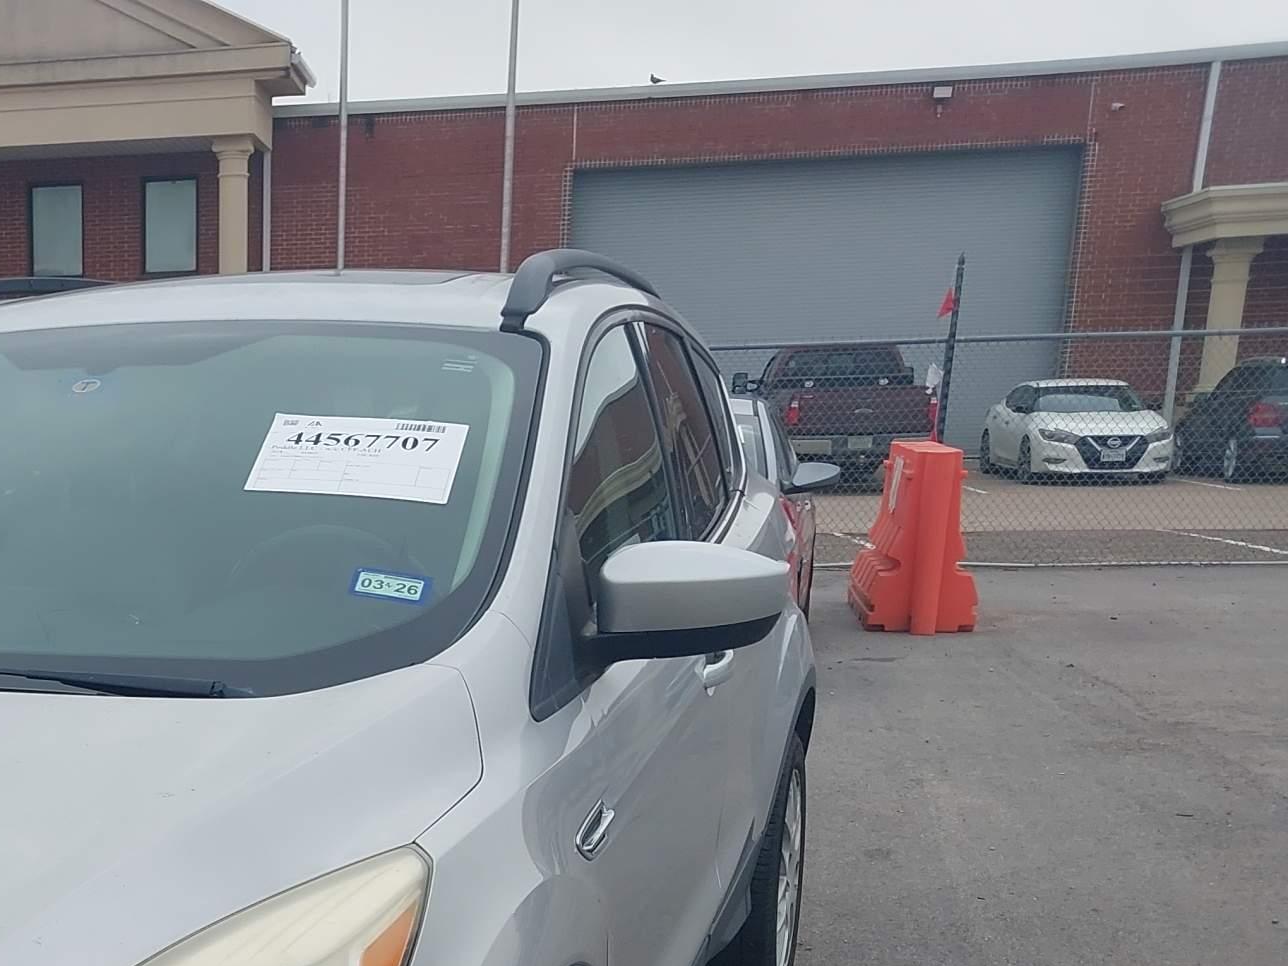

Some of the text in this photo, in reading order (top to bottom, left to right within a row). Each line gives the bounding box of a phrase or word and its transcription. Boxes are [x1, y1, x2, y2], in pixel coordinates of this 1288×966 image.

[286, 431, 441, 453] 44567707
[360, 577, 419, 595] 03 26
